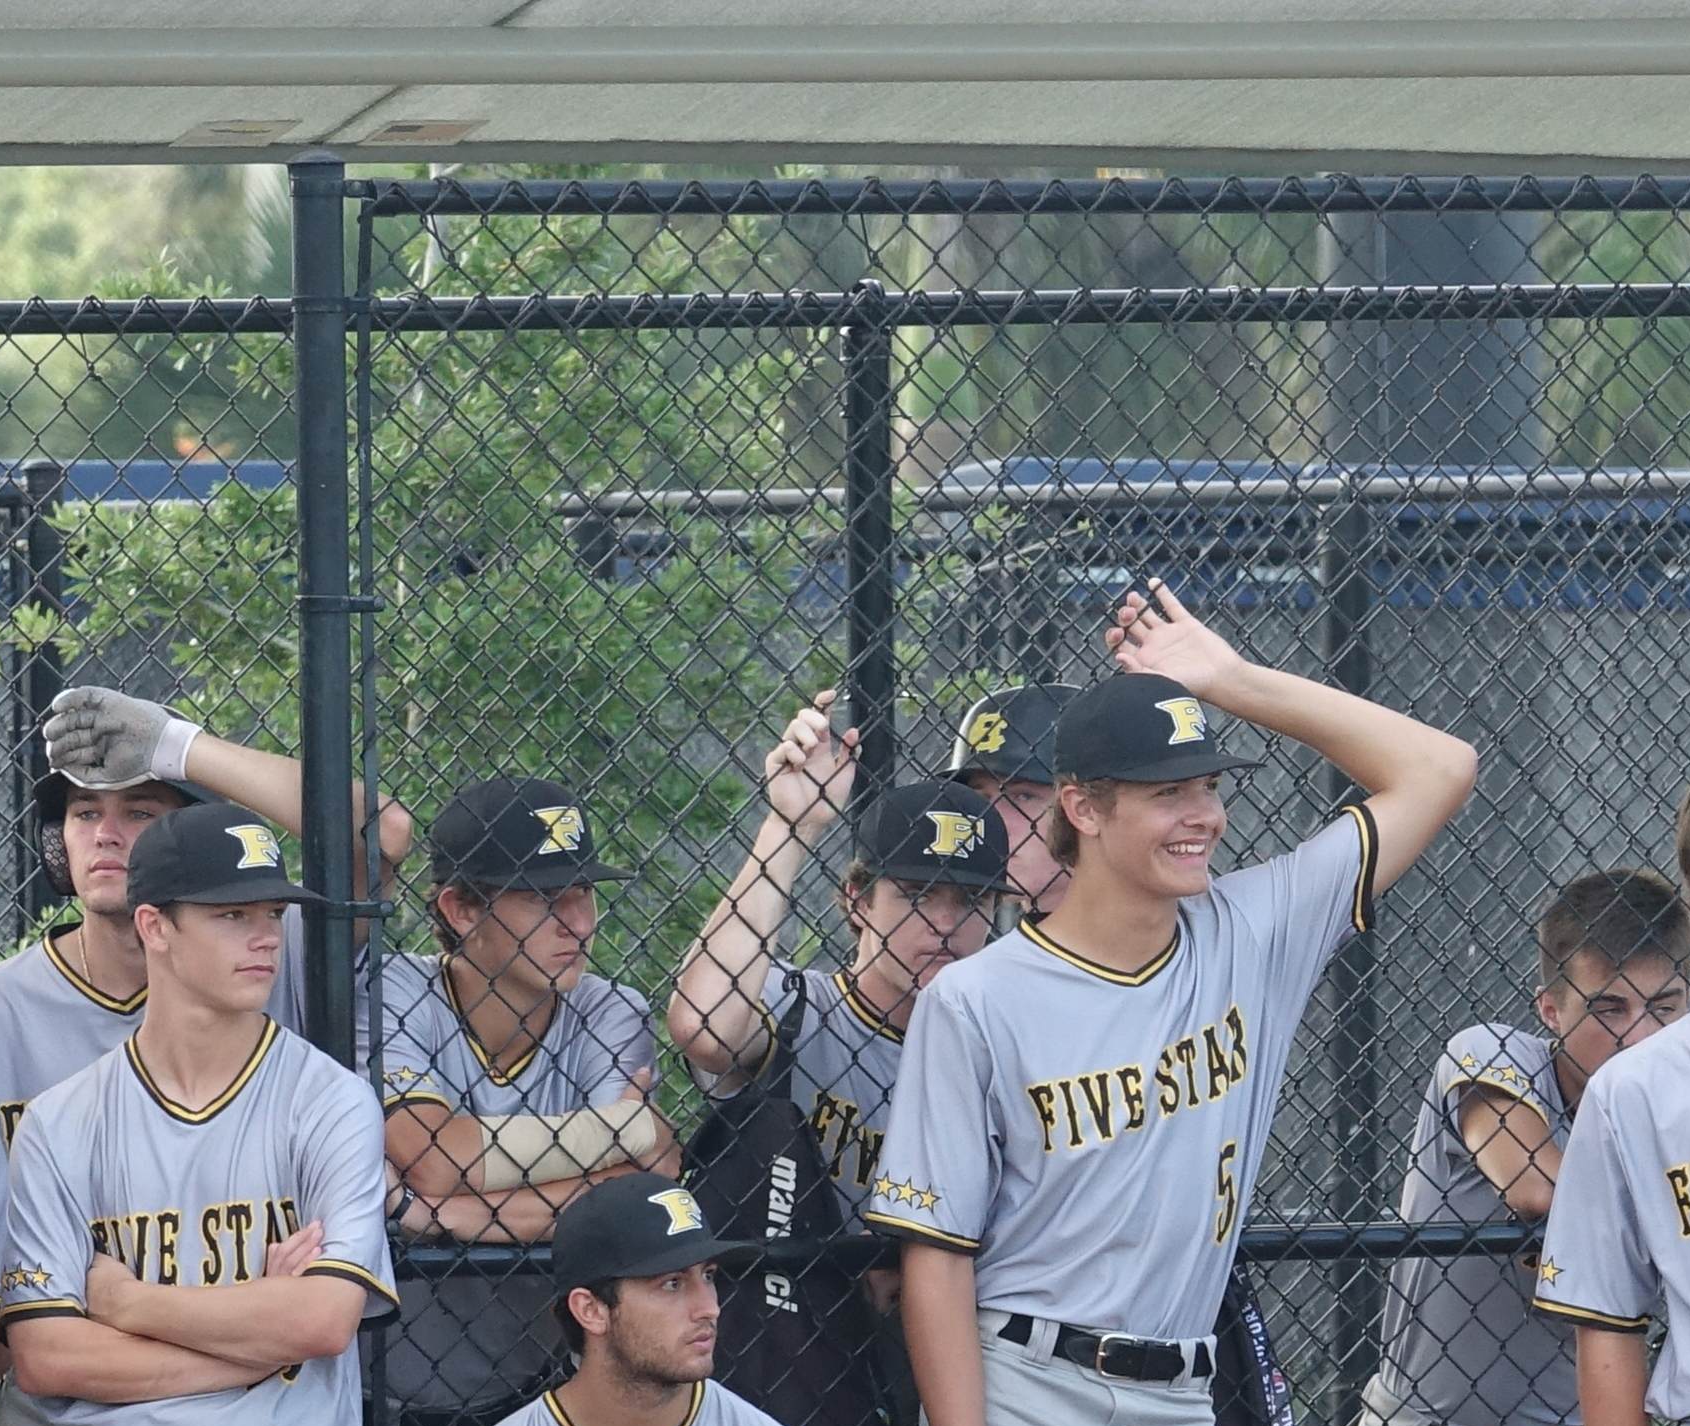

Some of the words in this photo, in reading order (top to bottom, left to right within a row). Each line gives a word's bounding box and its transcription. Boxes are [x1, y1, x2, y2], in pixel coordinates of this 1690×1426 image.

[812, 1090, 886, 1188] FIV
[1027, 1063, 1146, 1153] FIVE
[1154, 1004, 1249, 1118] STAR
[764, 1153, 799, 1314] maruci
[1215, 1141, 1237, 1246] 5
